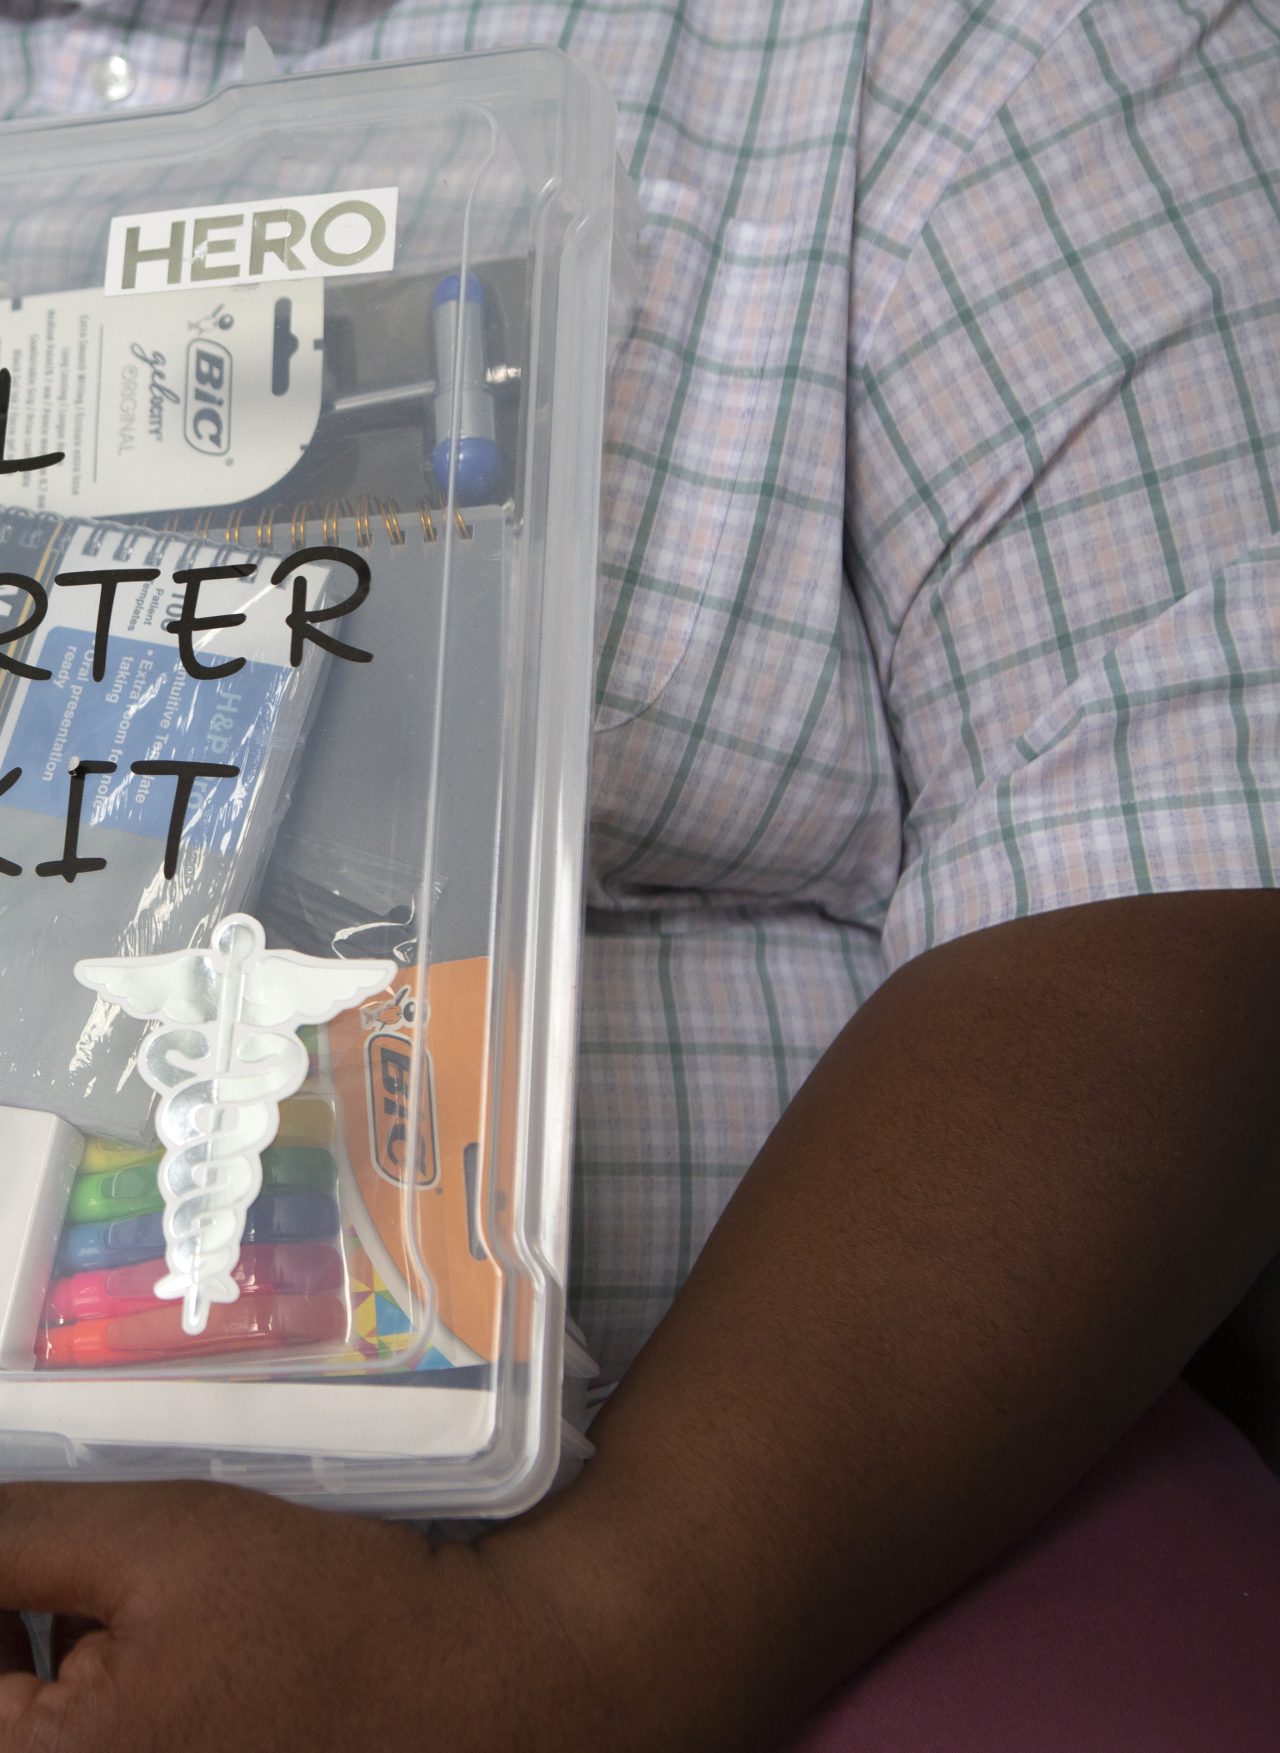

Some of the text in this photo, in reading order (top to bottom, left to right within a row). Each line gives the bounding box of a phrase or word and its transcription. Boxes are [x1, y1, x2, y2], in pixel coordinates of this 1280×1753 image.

[122, 200, 386, 289] HERO
[118, 365, 139, 456] ORIGINAL
[193, 347, 224, 449] BIC
[127, 581, 154, 631] emplates
[144, 587, 164, 626] Patient
[52, 645, 78, 689] ready
[105, 656, 135, 704] taking
[128, 659, 154, 701] Extra
[159, 664, 187, 729] ntuitive
[42, 649, 95, 781] Oral presentation
[207, 692, 242, 754] H&P
